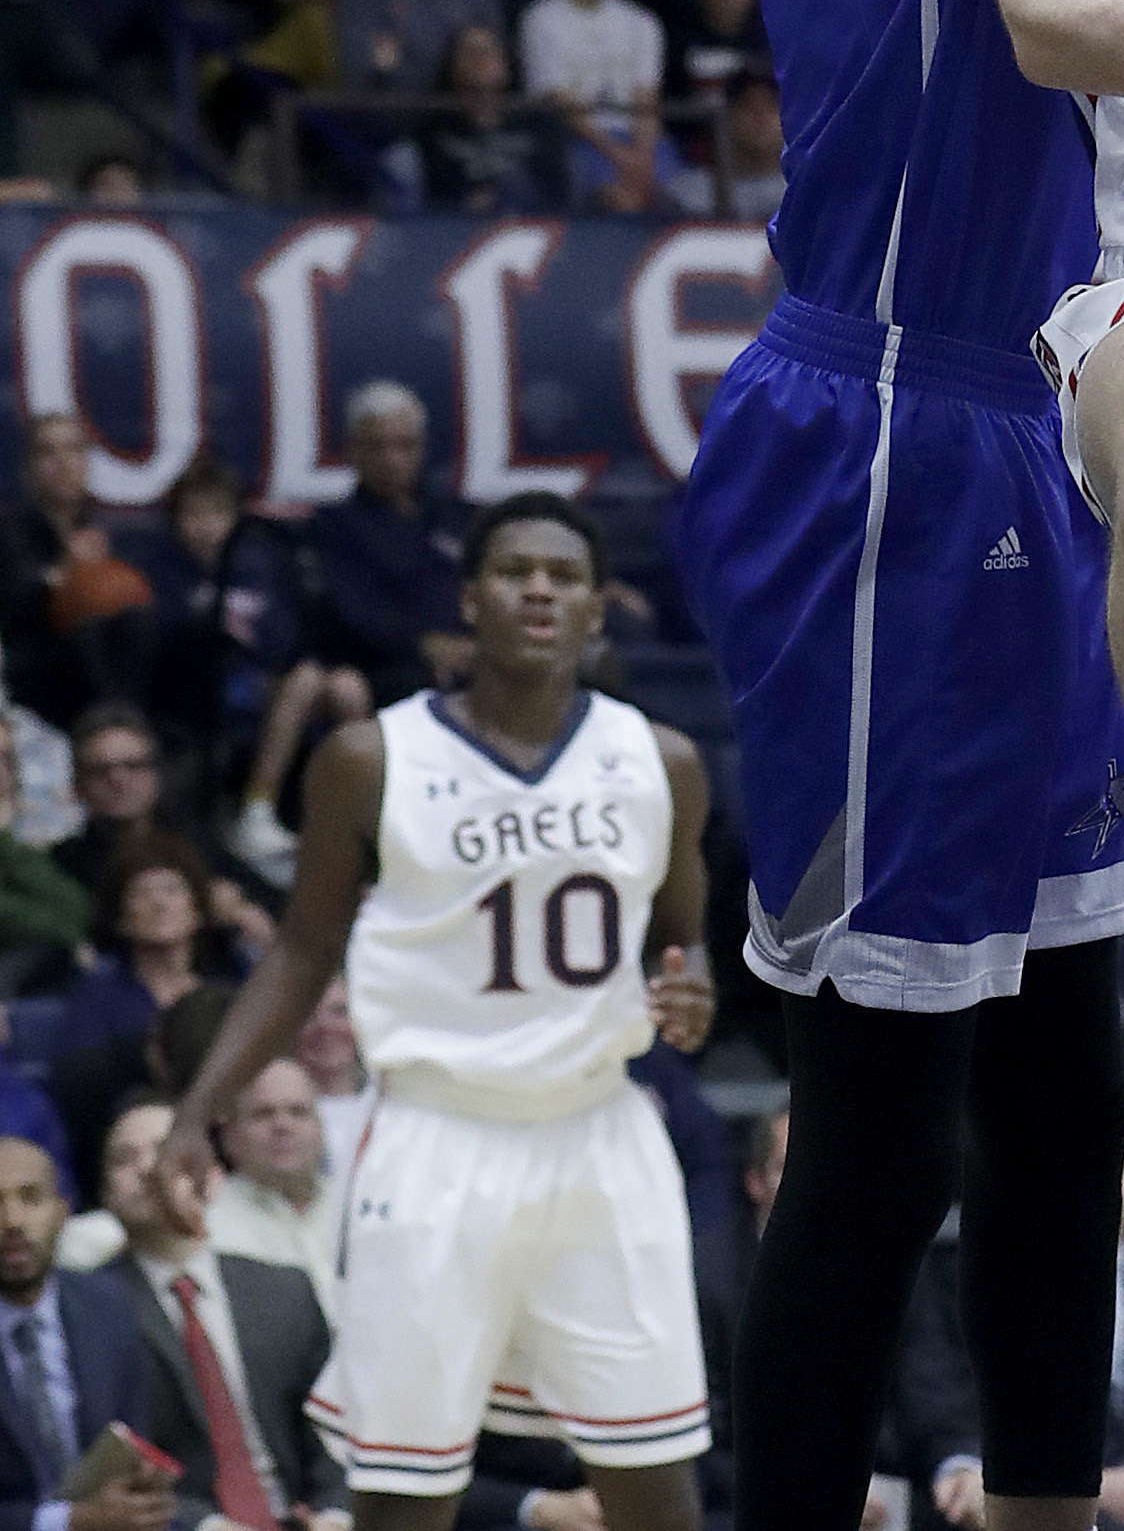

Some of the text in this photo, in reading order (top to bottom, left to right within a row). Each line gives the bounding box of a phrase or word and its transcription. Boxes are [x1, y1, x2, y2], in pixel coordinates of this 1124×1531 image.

[983, 554, 1030, 570] adidas
[453, 799, 622, 863] GAELS
[475, 872, 621, 992] 10
